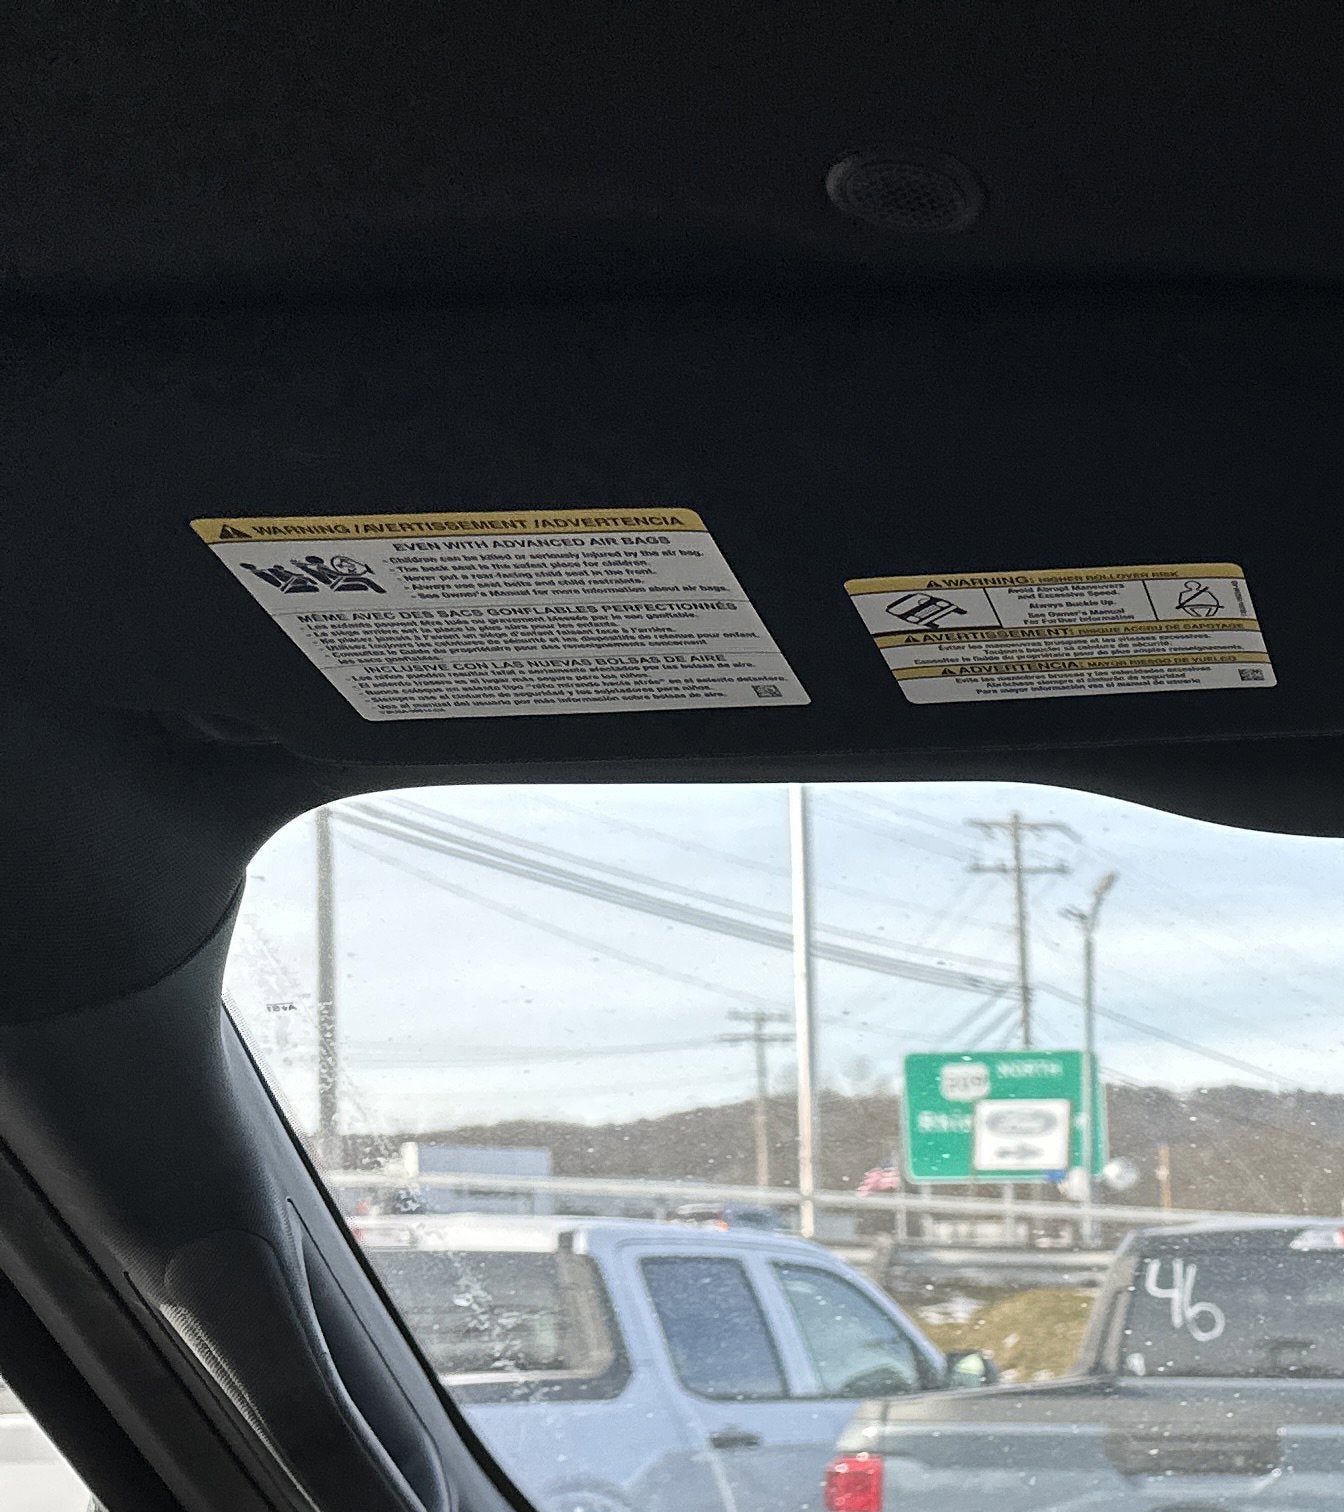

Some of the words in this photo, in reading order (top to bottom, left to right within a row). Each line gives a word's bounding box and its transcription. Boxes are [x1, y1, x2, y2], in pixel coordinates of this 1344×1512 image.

[254, 524, 352, 535] WARNING
[393, 542, 441, 551] EVEN
[445, 541, 489, 550] WITH
[491, 538, 586, 548] ADVANCED
[589, 537, 619, 545] AIR
[622, 536, 671, 544] BAGS
[529, 551, 581, 560] seriously
[296, 612, 349, 622] MÊME
[351, 611, 397, 620] AVEC
[399, 609, 435, 619] DES
[436, 608, 485, 617] SACS
[486, 604, 599, 616] GONFLABLES
[601, 600, 738, 613] PERFECTIONNÉS
[365, 664, 450, 673] INCLUSIVE
[452, 662, 490, 670] CON
[527, 658, 592, 667] NUEVAS
[595, 656, 661, 664] BOLSAS
[689, 654, 727, 662] AIRE
[1145, 1258, 1225, 1342] 46
